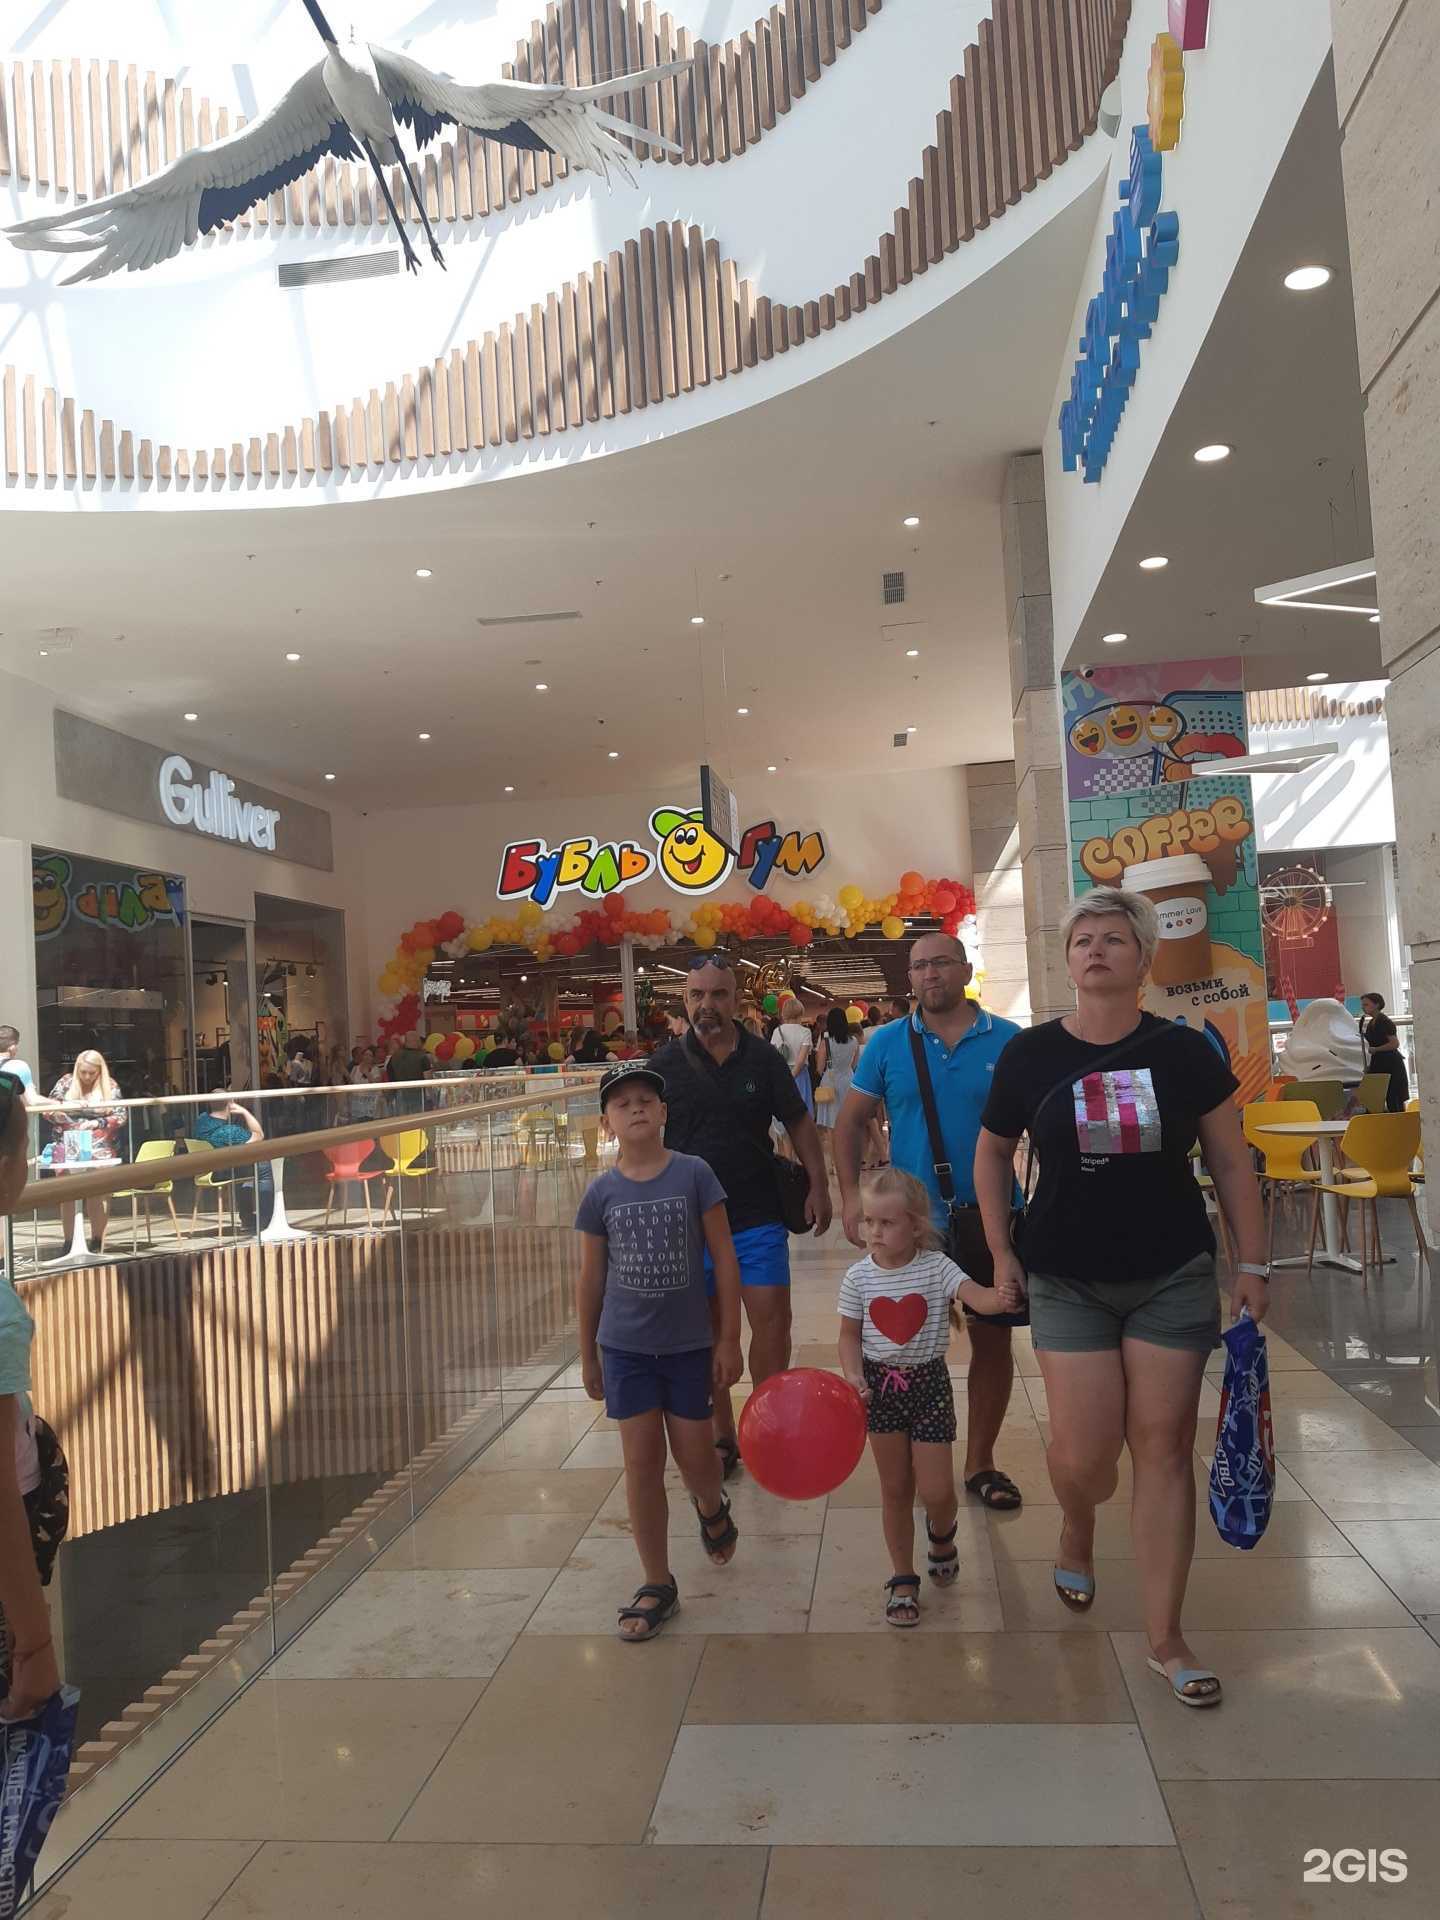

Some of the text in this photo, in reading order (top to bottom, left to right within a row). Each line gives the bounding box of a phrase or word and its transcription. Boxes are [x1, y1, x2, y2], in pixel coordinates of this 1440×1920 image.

[160, 755, 280, 851] Gulliver
[1166, 978, 1224, 997] возьми
[1203, 984, 1250, 1004] собой
[614, 1200, 683, 1217] MILANO
[614, 1214, 683, 1229] LONDON
